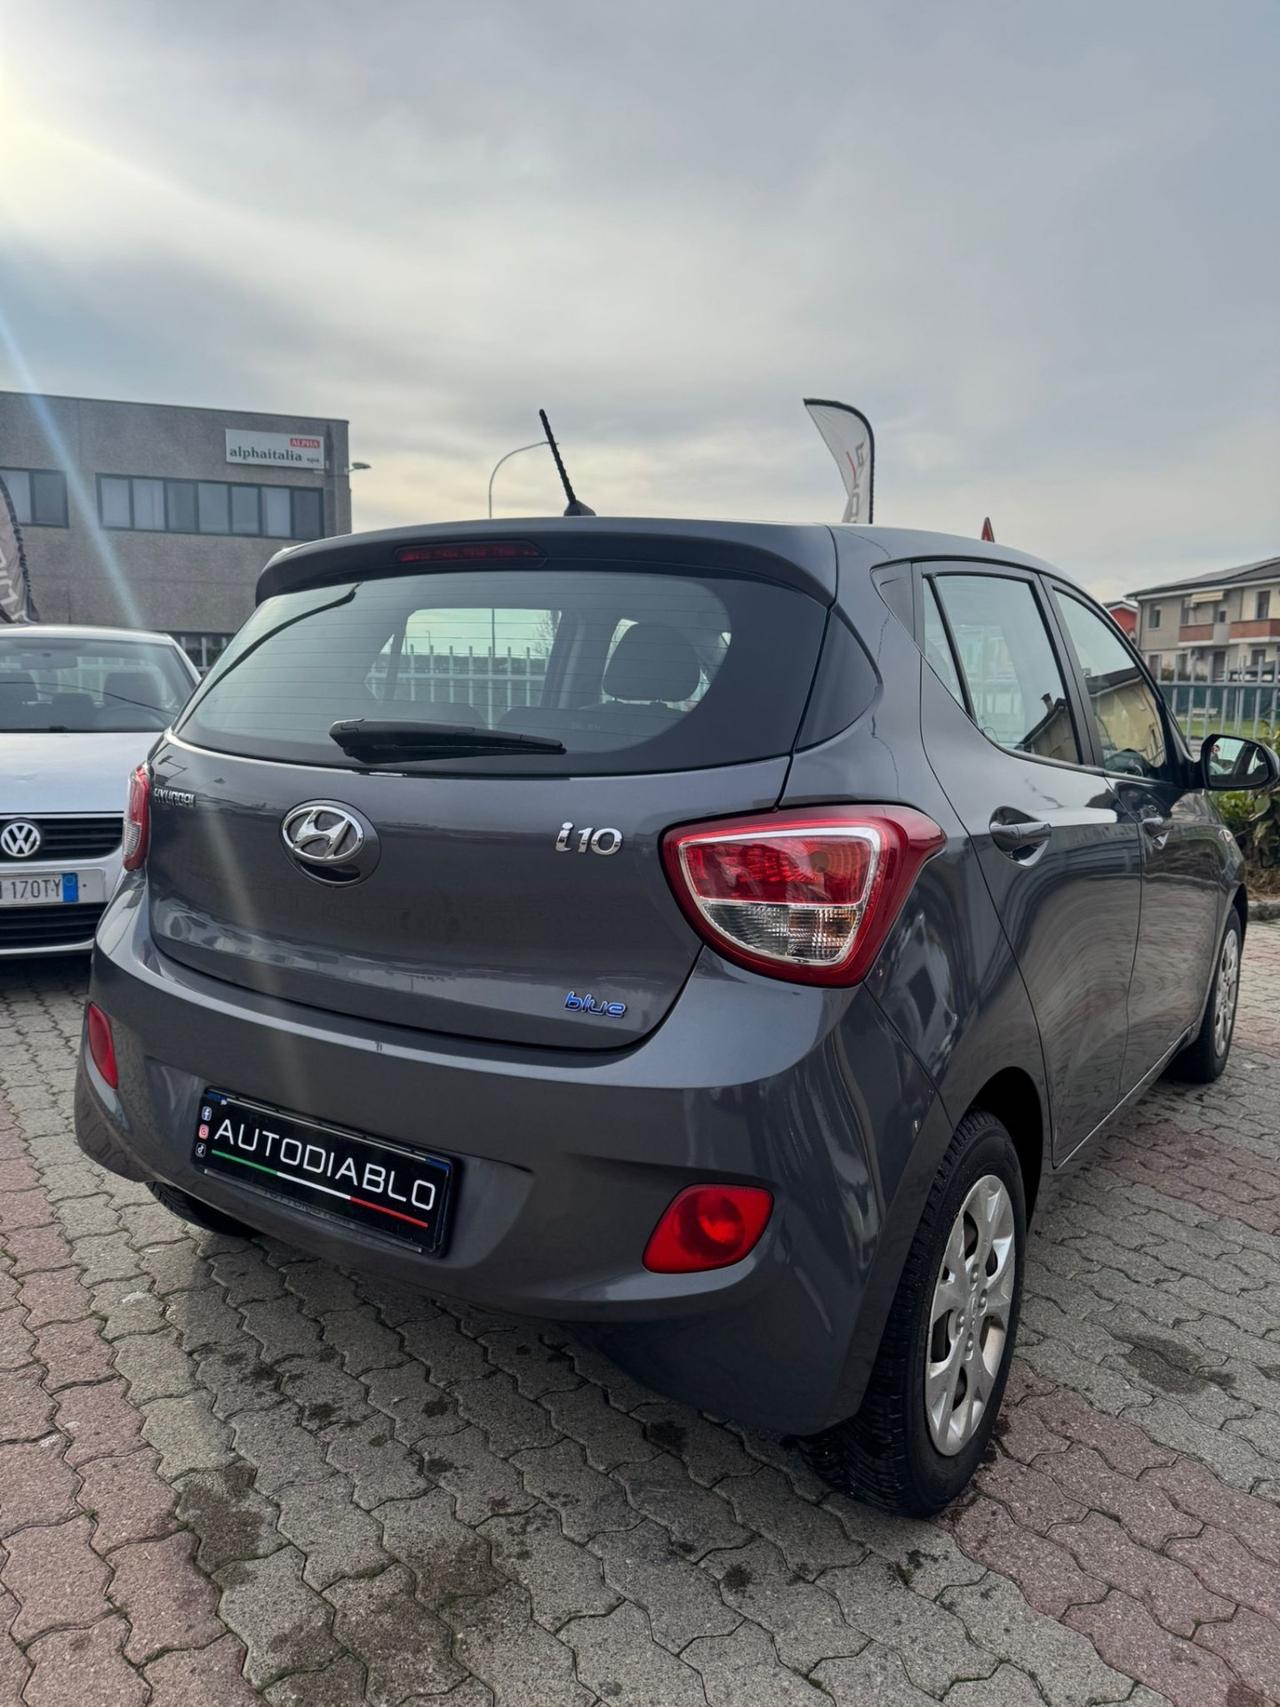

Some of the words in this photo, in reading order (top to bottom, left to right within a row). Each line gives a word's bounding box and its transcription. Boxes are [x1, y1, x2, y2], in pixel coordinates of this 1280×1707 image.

[229, 446, 302, 461] alphaitalia
[290, 438, 320, 448] ALPHA
[556, 822, 622, 855] i10
[564, 990, 626, 1018] blue
[214, 1119, 435, 1211] AUTODIABLO
